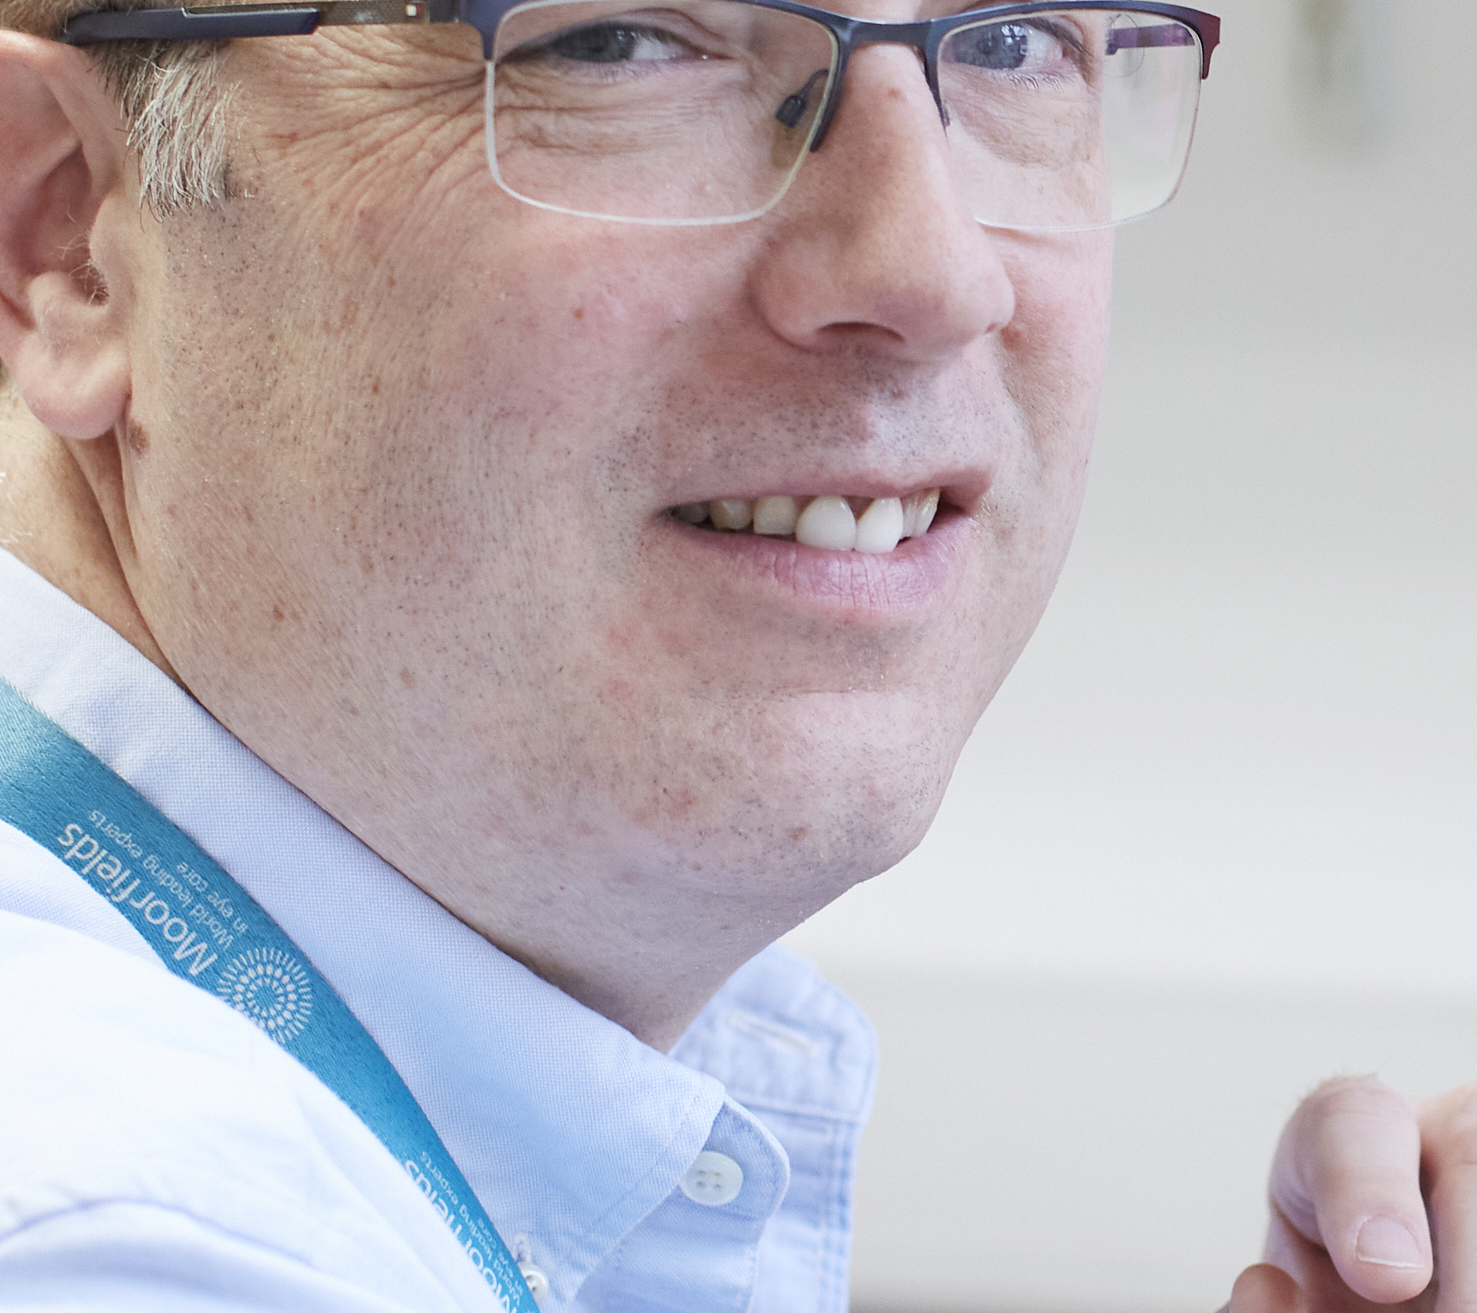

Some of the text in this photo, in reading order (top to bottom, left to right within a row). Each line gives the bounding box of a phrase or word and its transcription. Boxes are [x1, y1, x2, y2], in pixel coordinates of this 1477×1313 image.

[57, 824, 216, 976] Moorfields
[88, 809, 234, 950] World leading experts
[175, 861, 248, 936] in eye care
